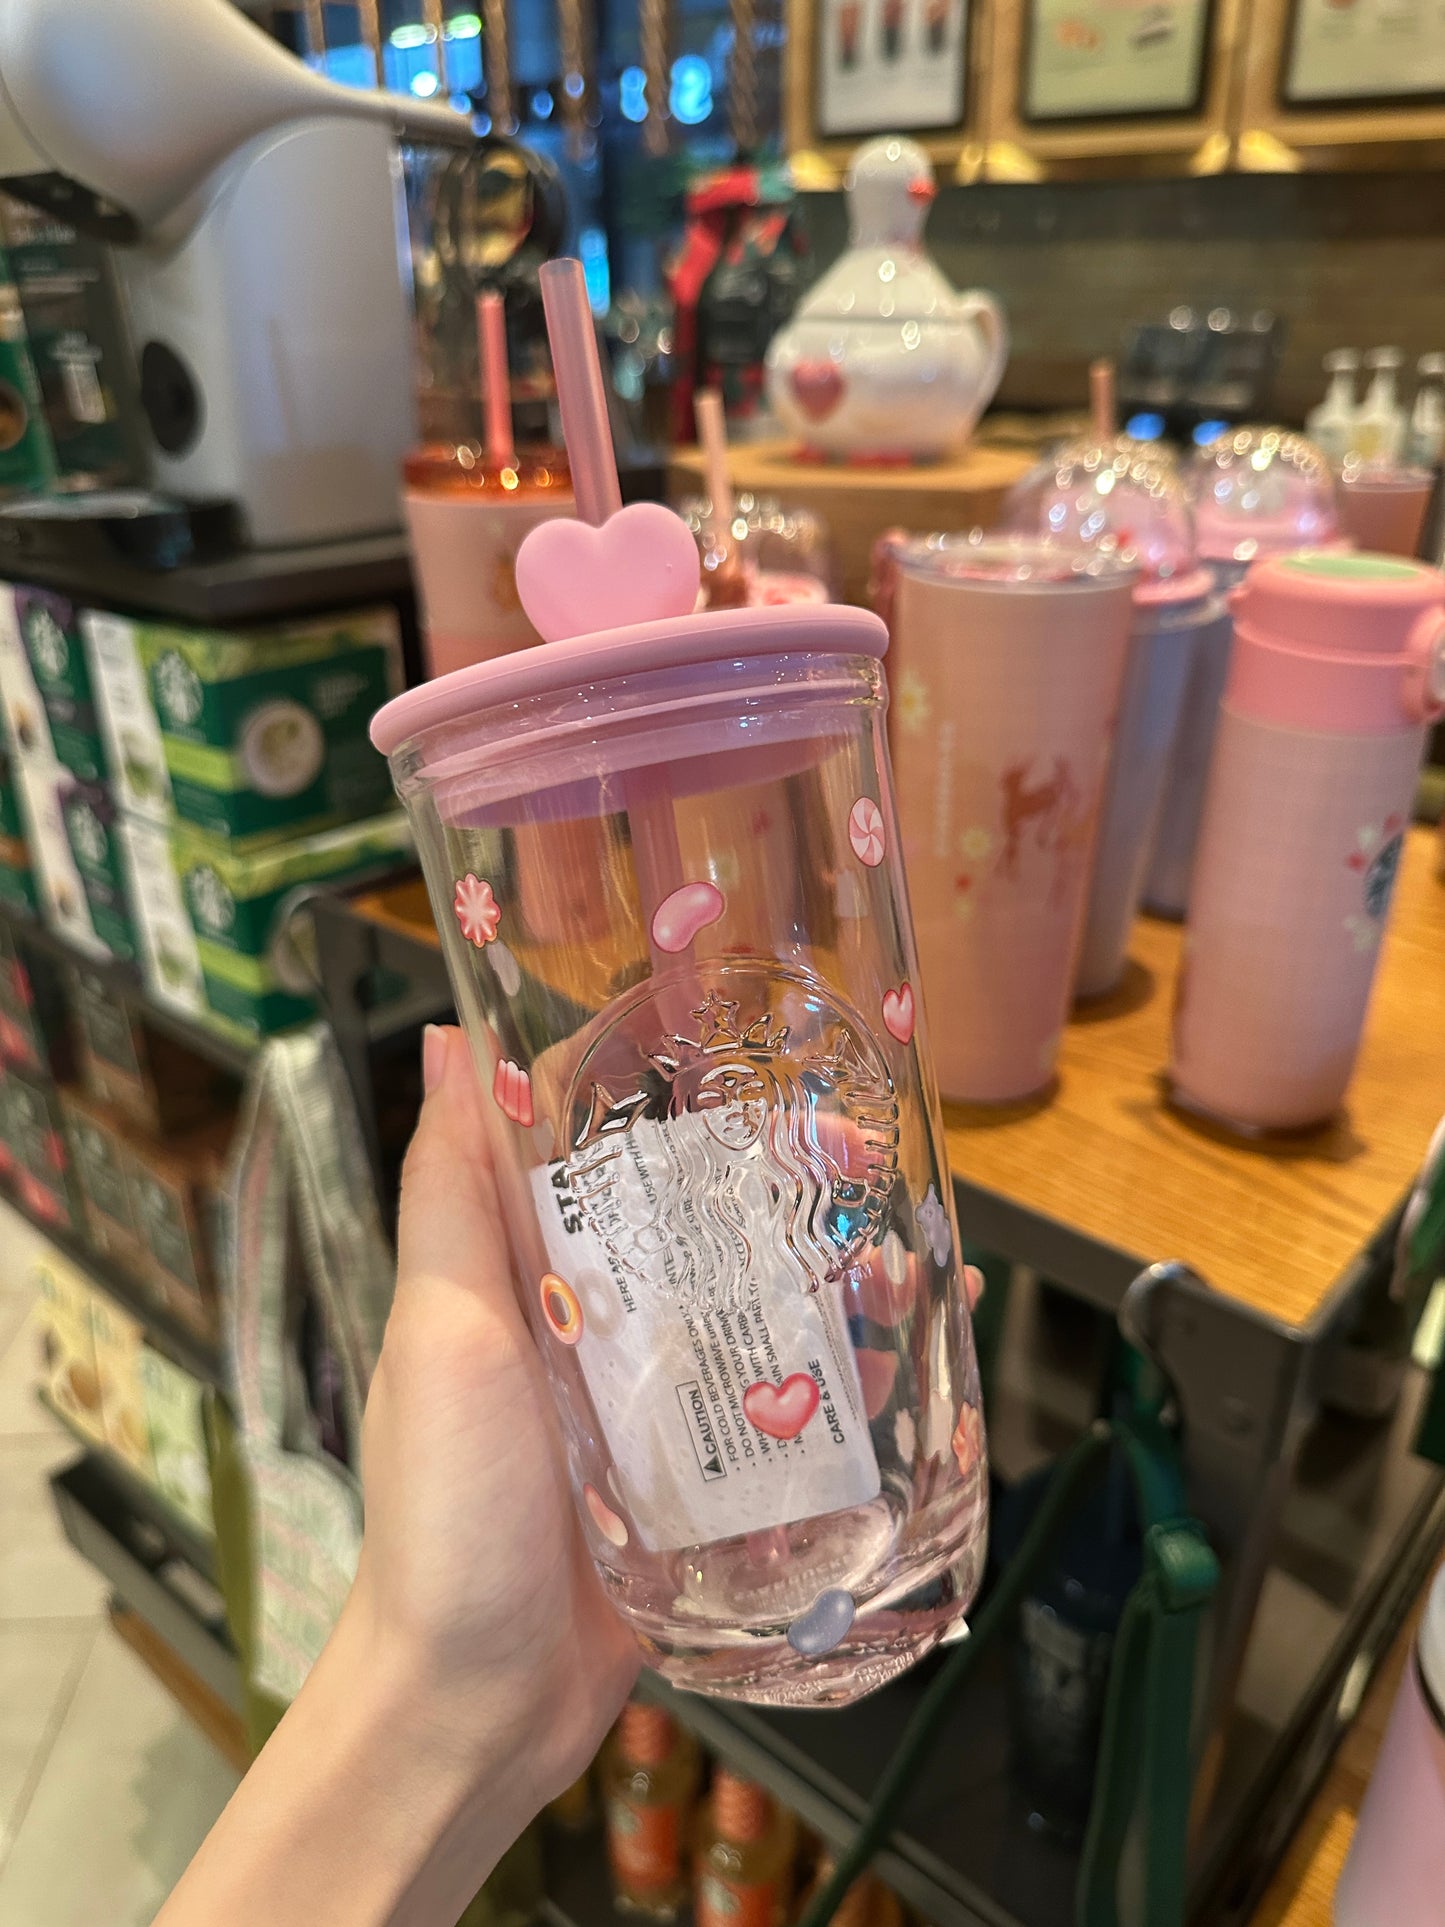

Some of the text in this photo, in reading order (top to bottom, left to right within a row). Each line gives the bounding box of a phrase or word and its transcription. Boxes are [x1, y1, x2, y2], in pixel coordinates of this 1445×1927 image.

[615, 1273, 636, 1313] HERE
[760, 1326, 778, 1363] SMALL
[692, 1340, 721, 1402] BEVERAGES
[711, 1340, 741, 1411] MICROWAVE
[731, 1345, 747, 1381] YOUR
[750, 1348, 765, 1378] WITH
[808, 1358, 826, 1387] USE
[713, 1394, 731, 1436] COLD
[822, 1393, 831, 1401] &
[688, 1389, 718, 1455] CAUTION
[732, 1410, 750, 1437] NOT
[822, 1402, 845, 1444] CARE
[725, 1437, 739, 1462] FOR
[743, 1440, 756, 1458] DO
